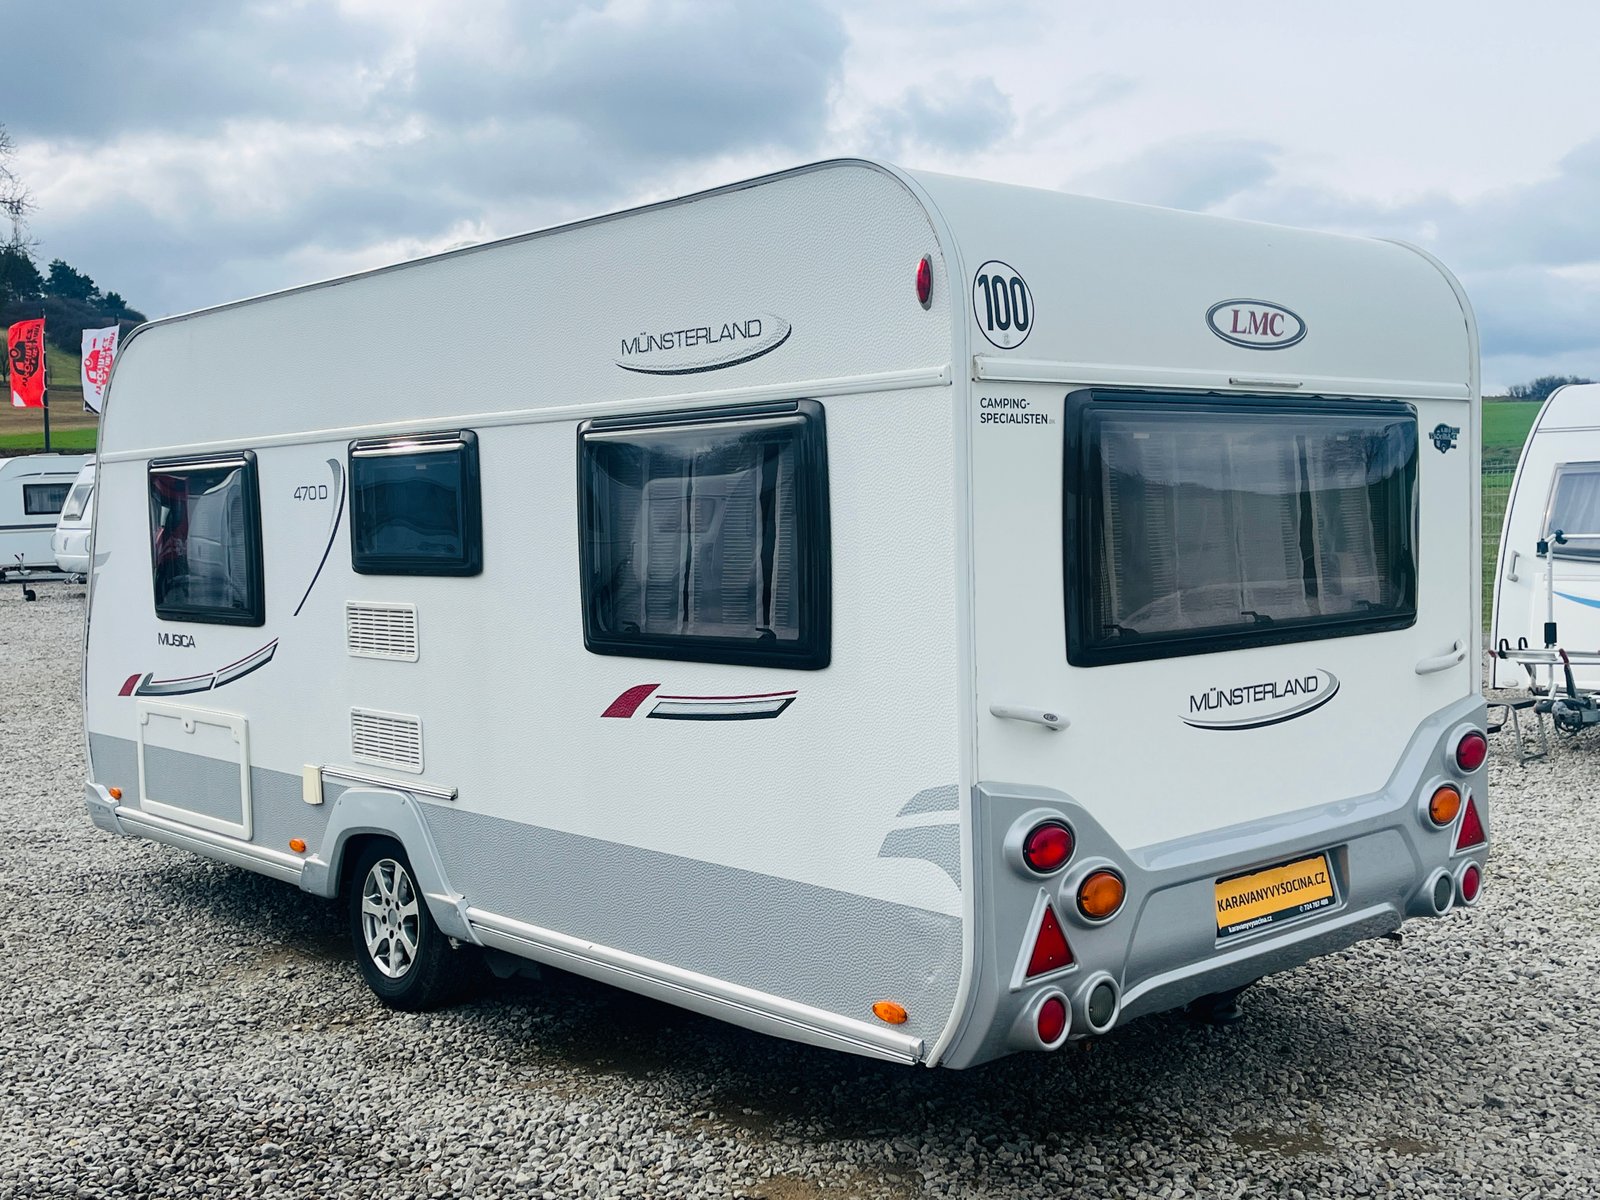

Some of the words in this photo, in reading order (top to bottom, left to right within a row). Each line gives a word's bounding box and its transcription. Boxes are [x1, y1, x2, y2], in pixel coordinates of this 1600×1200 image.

[978, 274, 1029, 332] 100
[1229, 308, 1285, 337] LMC
[621, 319, 762, 356] MÜNSTERLAND
[980, 397, 1030, 409] CAMPING-
[980, 412, 1048, 424] SPECIALISTEN
[293, 485, 317, 501] 470
[318, 484, 328, 500] D
[157, 632, 196, 648] MUSICA
[1189, 675, 1318, 713] MÜNSTERLAND
[1217, 871, 1326, 912] KARAVANYVYSOCINA.CZ
